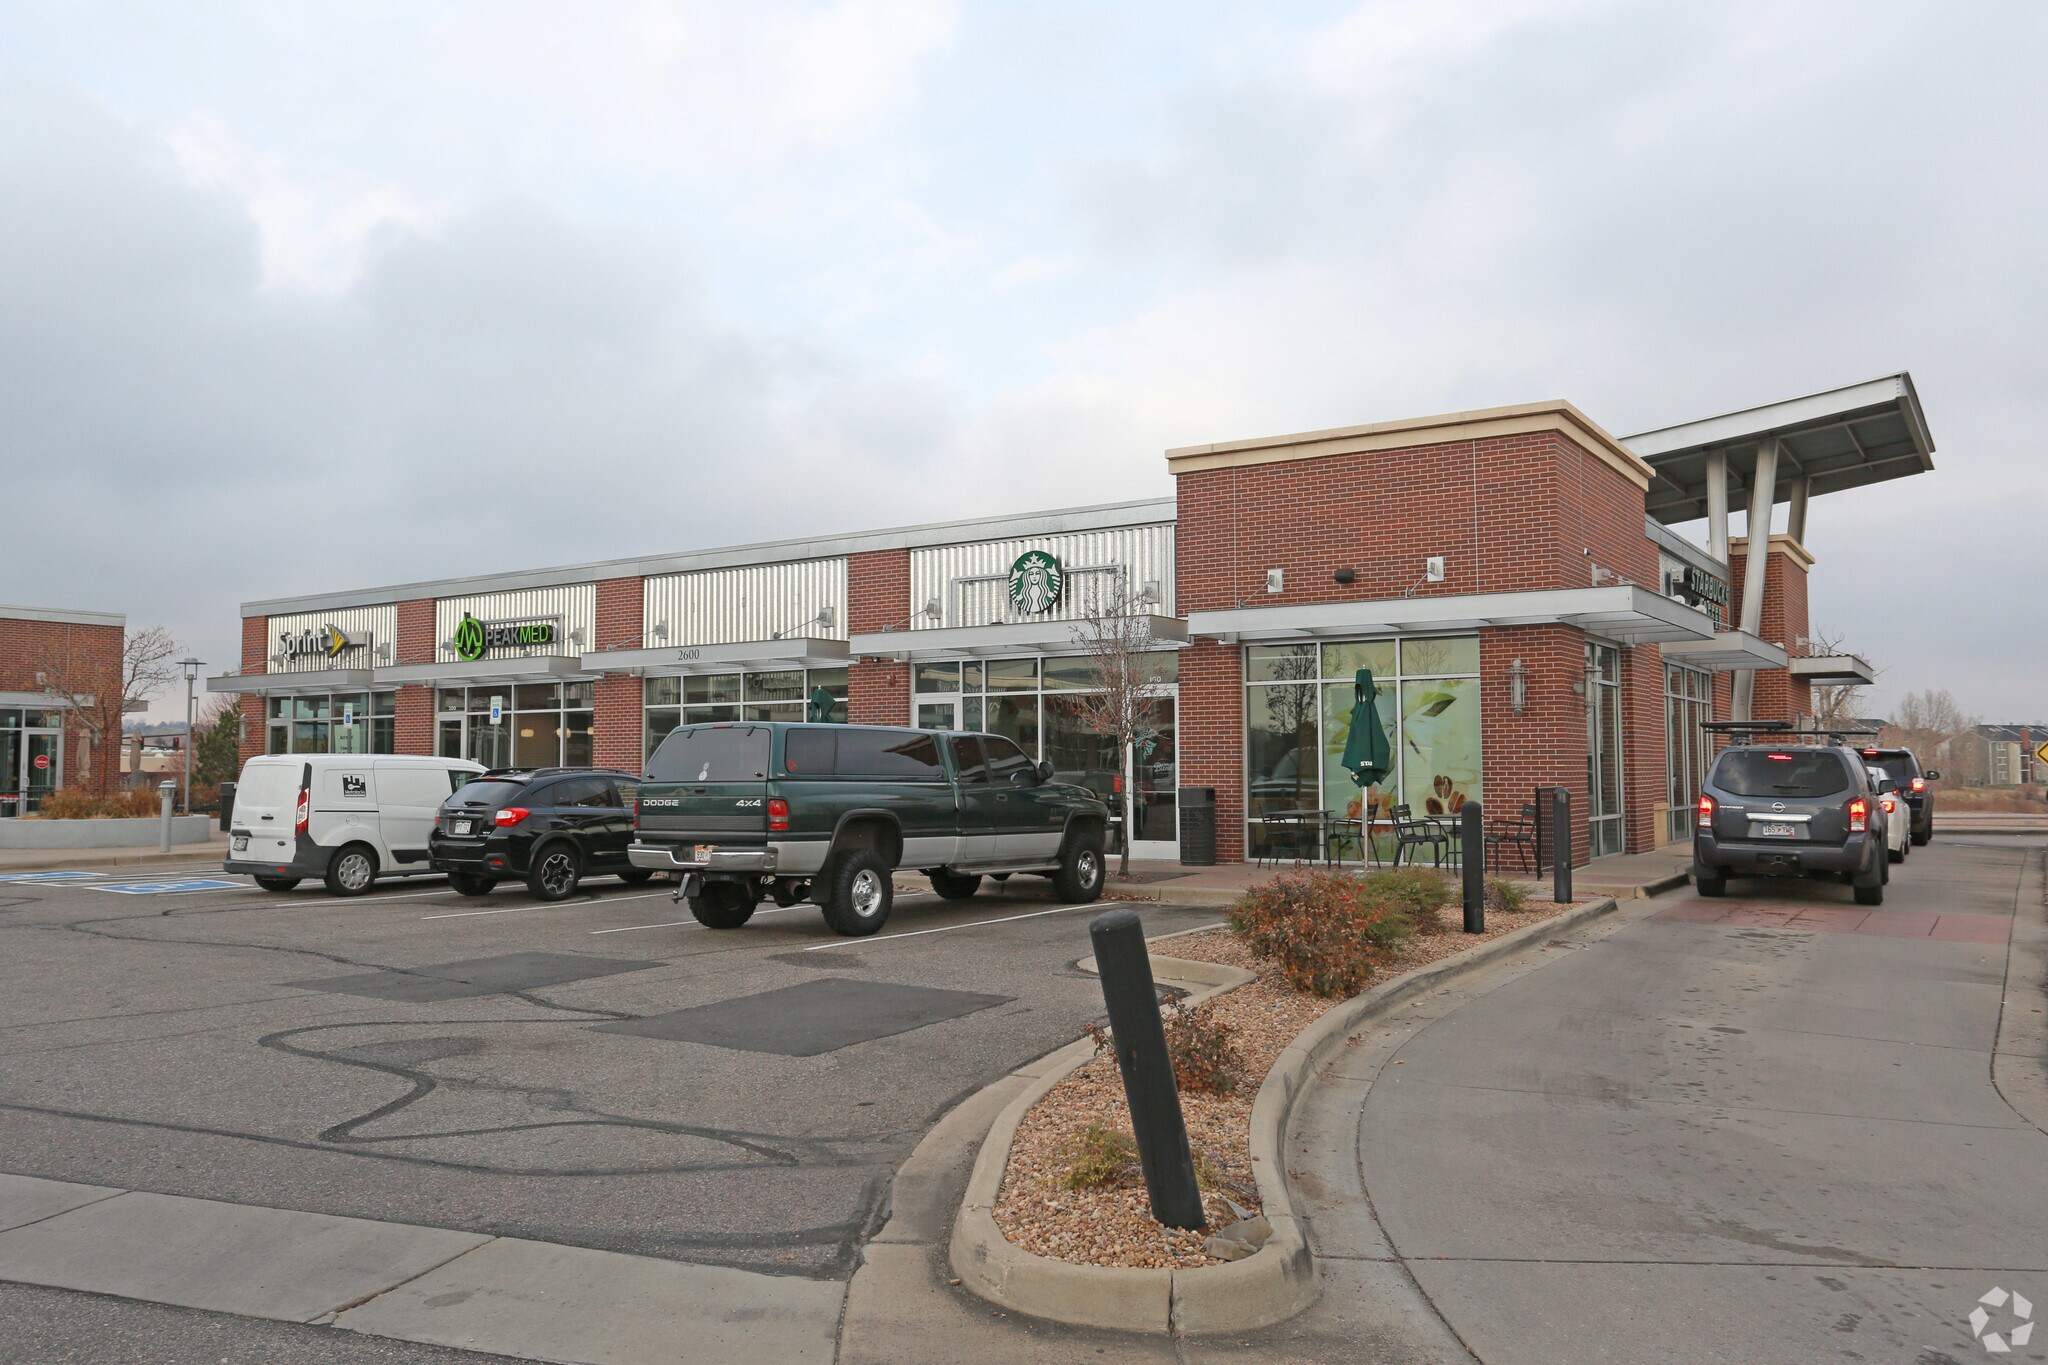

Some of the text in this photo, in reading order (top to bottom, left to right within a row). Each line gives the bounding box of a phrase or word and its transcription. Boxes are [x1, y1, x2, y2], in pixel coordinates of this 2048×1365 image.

[485, 624, 549, 646] PEAKMED
[278, 628, 324, 660] Sprint
[678, 649, 700, 660] 2600
[643, 799, 679, 807] DODGE
[735, 799, 762, 807] 4x4
